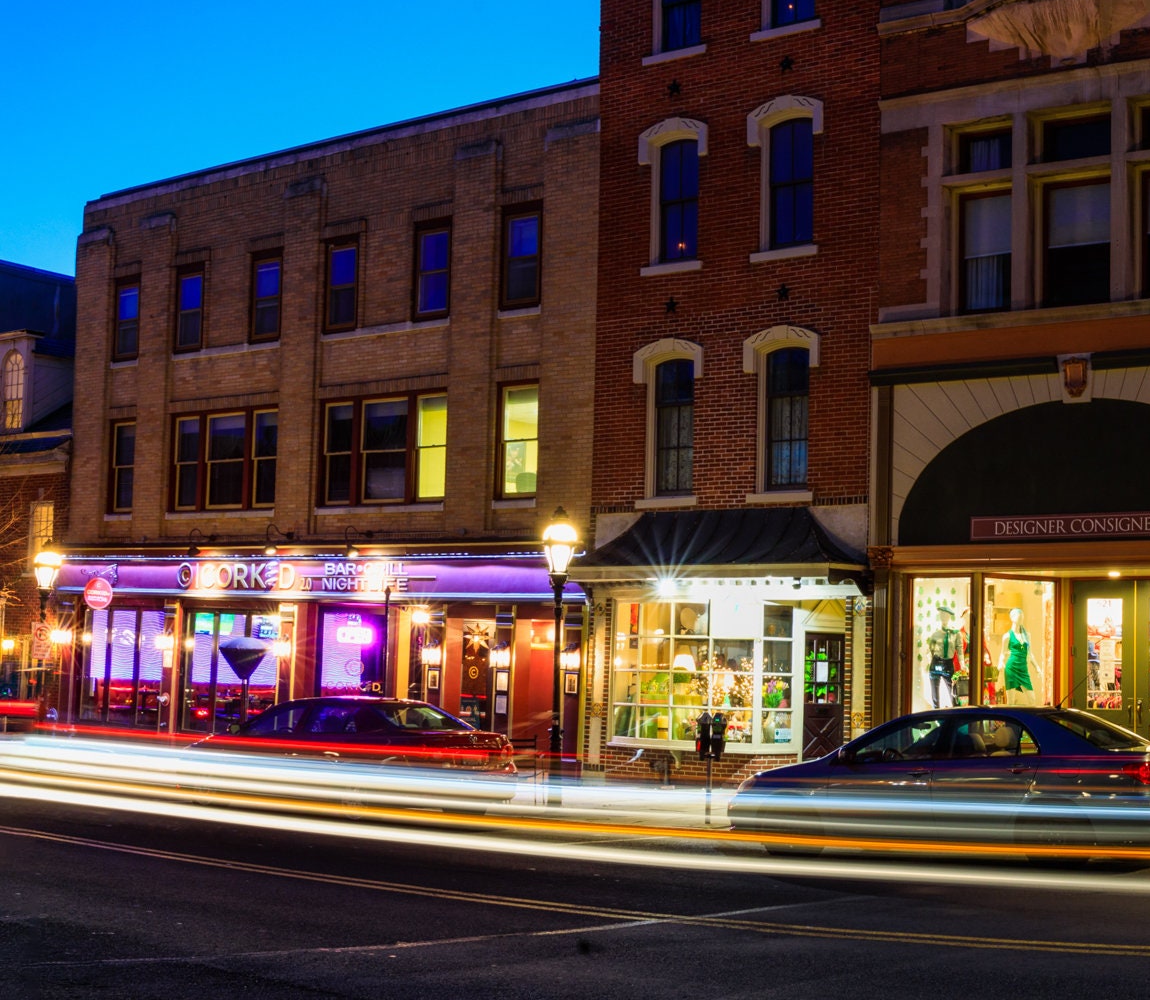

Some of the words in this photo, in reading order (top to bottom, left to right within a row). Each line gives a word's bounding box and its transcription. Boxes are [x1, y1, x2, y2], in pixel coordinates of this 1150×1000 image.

[994, 519, 1066, 536] DESIGNER
[364, 562, 409, 576] GILL
[322, 577, 408, 591] NIGHTIFE
